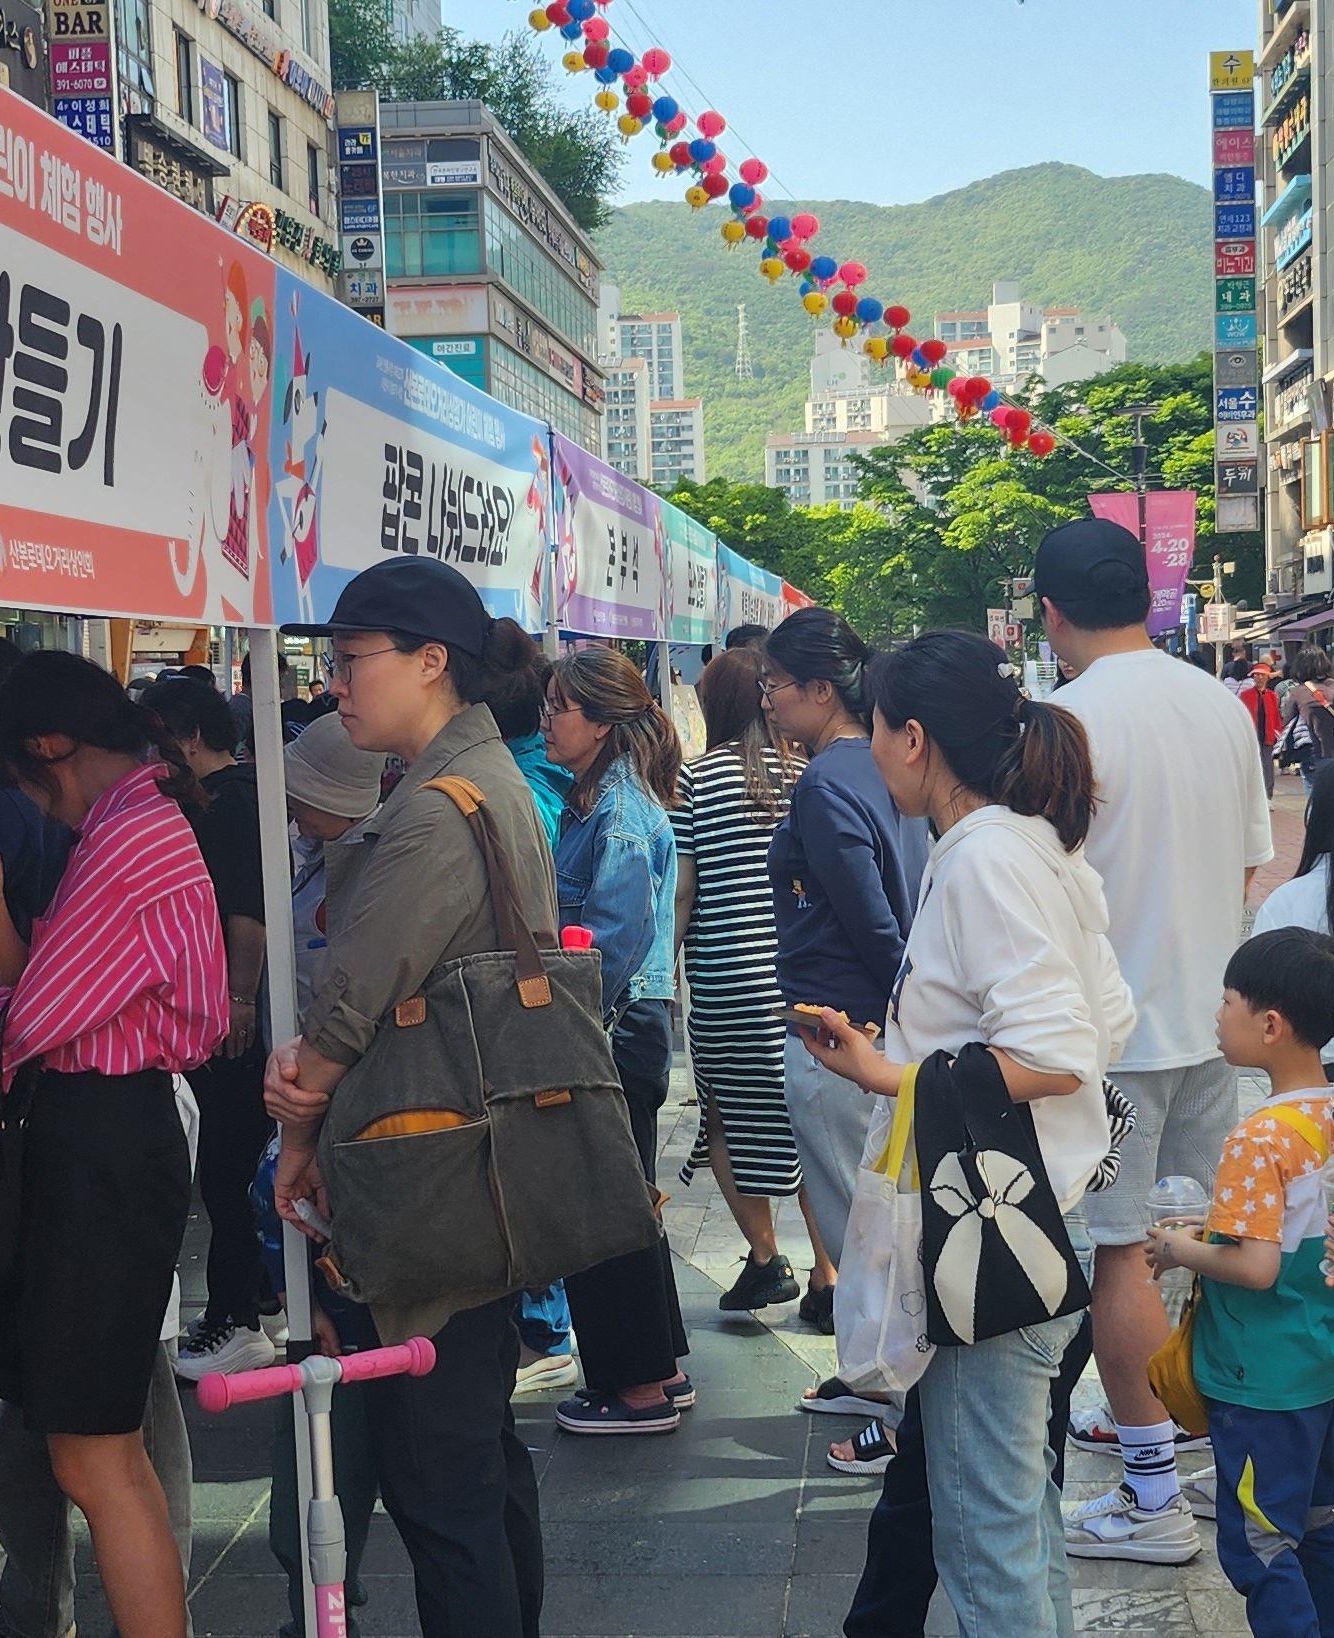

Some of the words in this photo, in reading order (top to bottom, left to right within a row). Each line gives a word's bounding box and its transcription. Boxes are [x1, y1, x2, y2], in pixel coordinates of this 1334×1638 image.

[54, 11, 104, 35] BAR
[56, 60, 106, 74] 에스테틱
[1222, 55, 1242, 75] 수
[56, 79, 92, 90] 391-6070
[71, 99, 110, 112] 이성희
[1216, 137, 1252, 151] 에이스
[1224, 183, 1246, 194] 치과
[40, 149, 82, 236] 체험
[86, 180, 123, 257] 행사
[350, 282, 377, 297] 치과
[1222, 290, 1250, 303] 내과
[436, 342, 471, 354] 야간진료
[1223, 465, 1252, 488] 두끼
[381, 442, 424, 555] 팝콘
[427, 462, 515, 567] 나눠드려요!
[1151, 538, 1189, 554] 4.20
[8, 539, 96, 581] 산본로데오거리상인회
